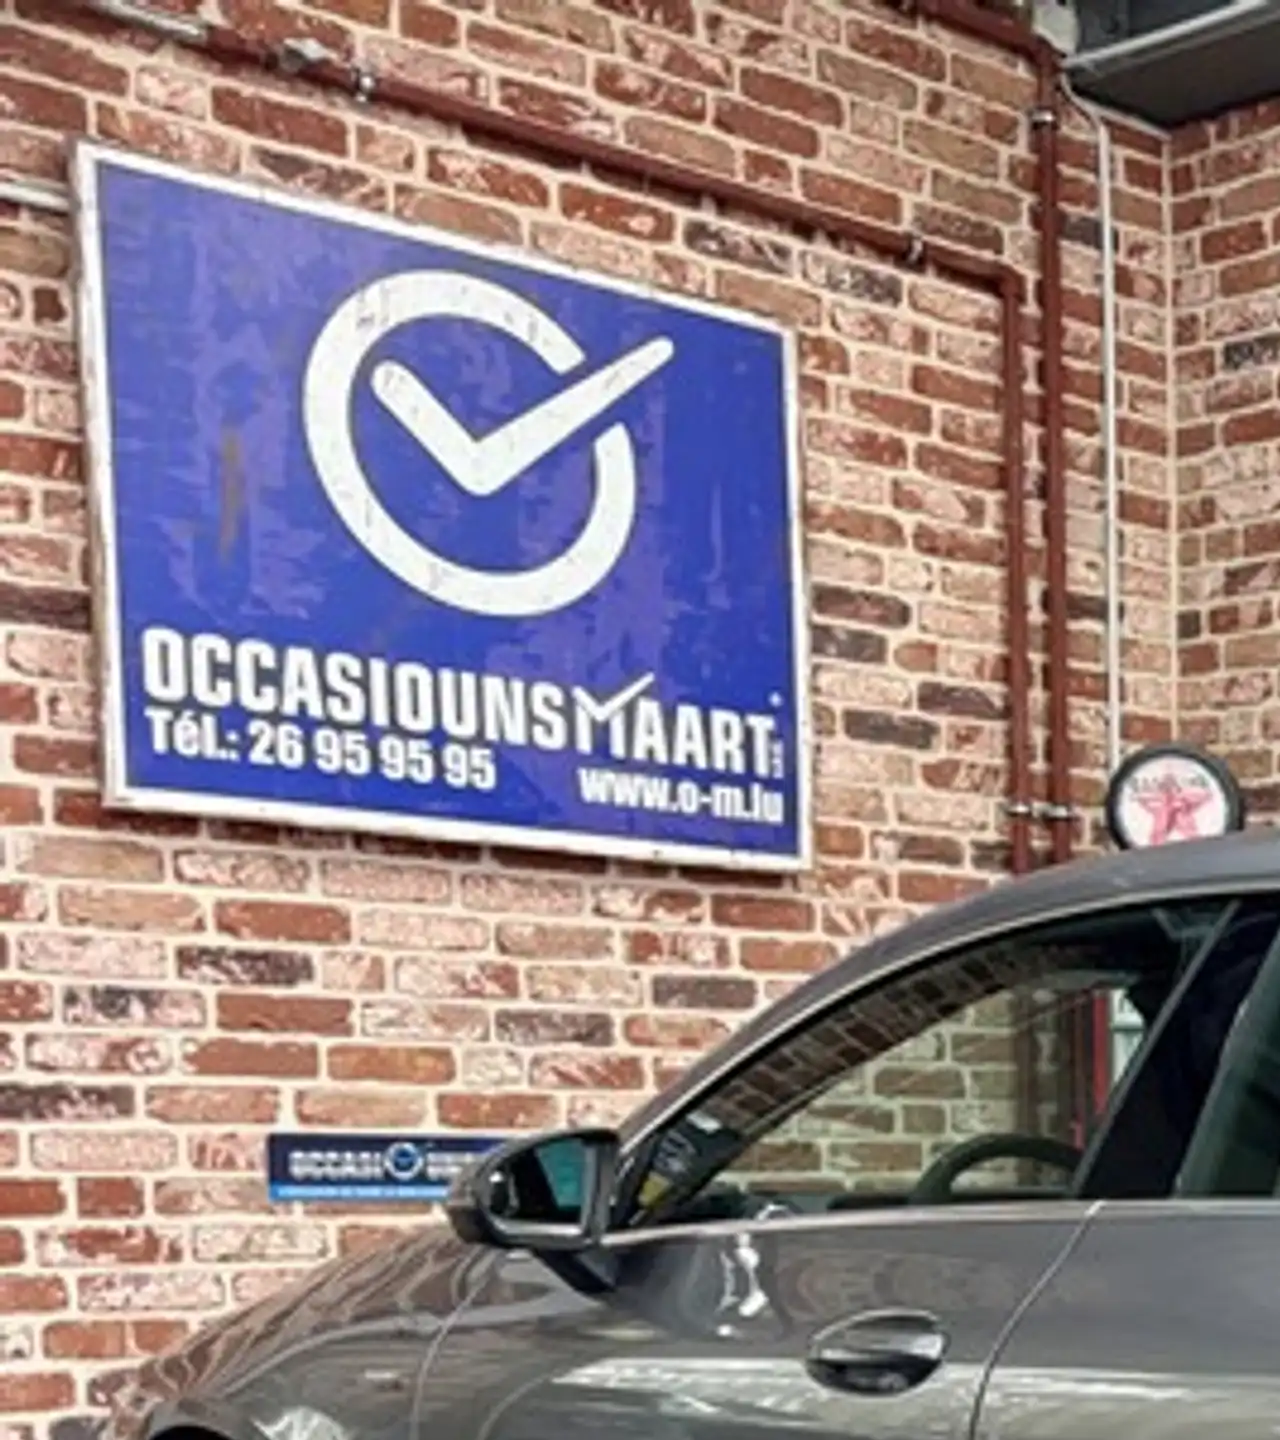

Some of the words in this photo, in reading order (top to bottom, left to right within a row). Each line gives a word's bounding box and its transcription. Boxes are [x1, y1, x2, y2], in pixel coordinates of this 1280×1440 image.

[249, 718, 303, 769] 26
[312, 727, 371, 776] 95
[378, 735, 434, 783] 95
[442, 744, 497, 790] 95
[576, 766, 785, 824] www.o-m.lu
